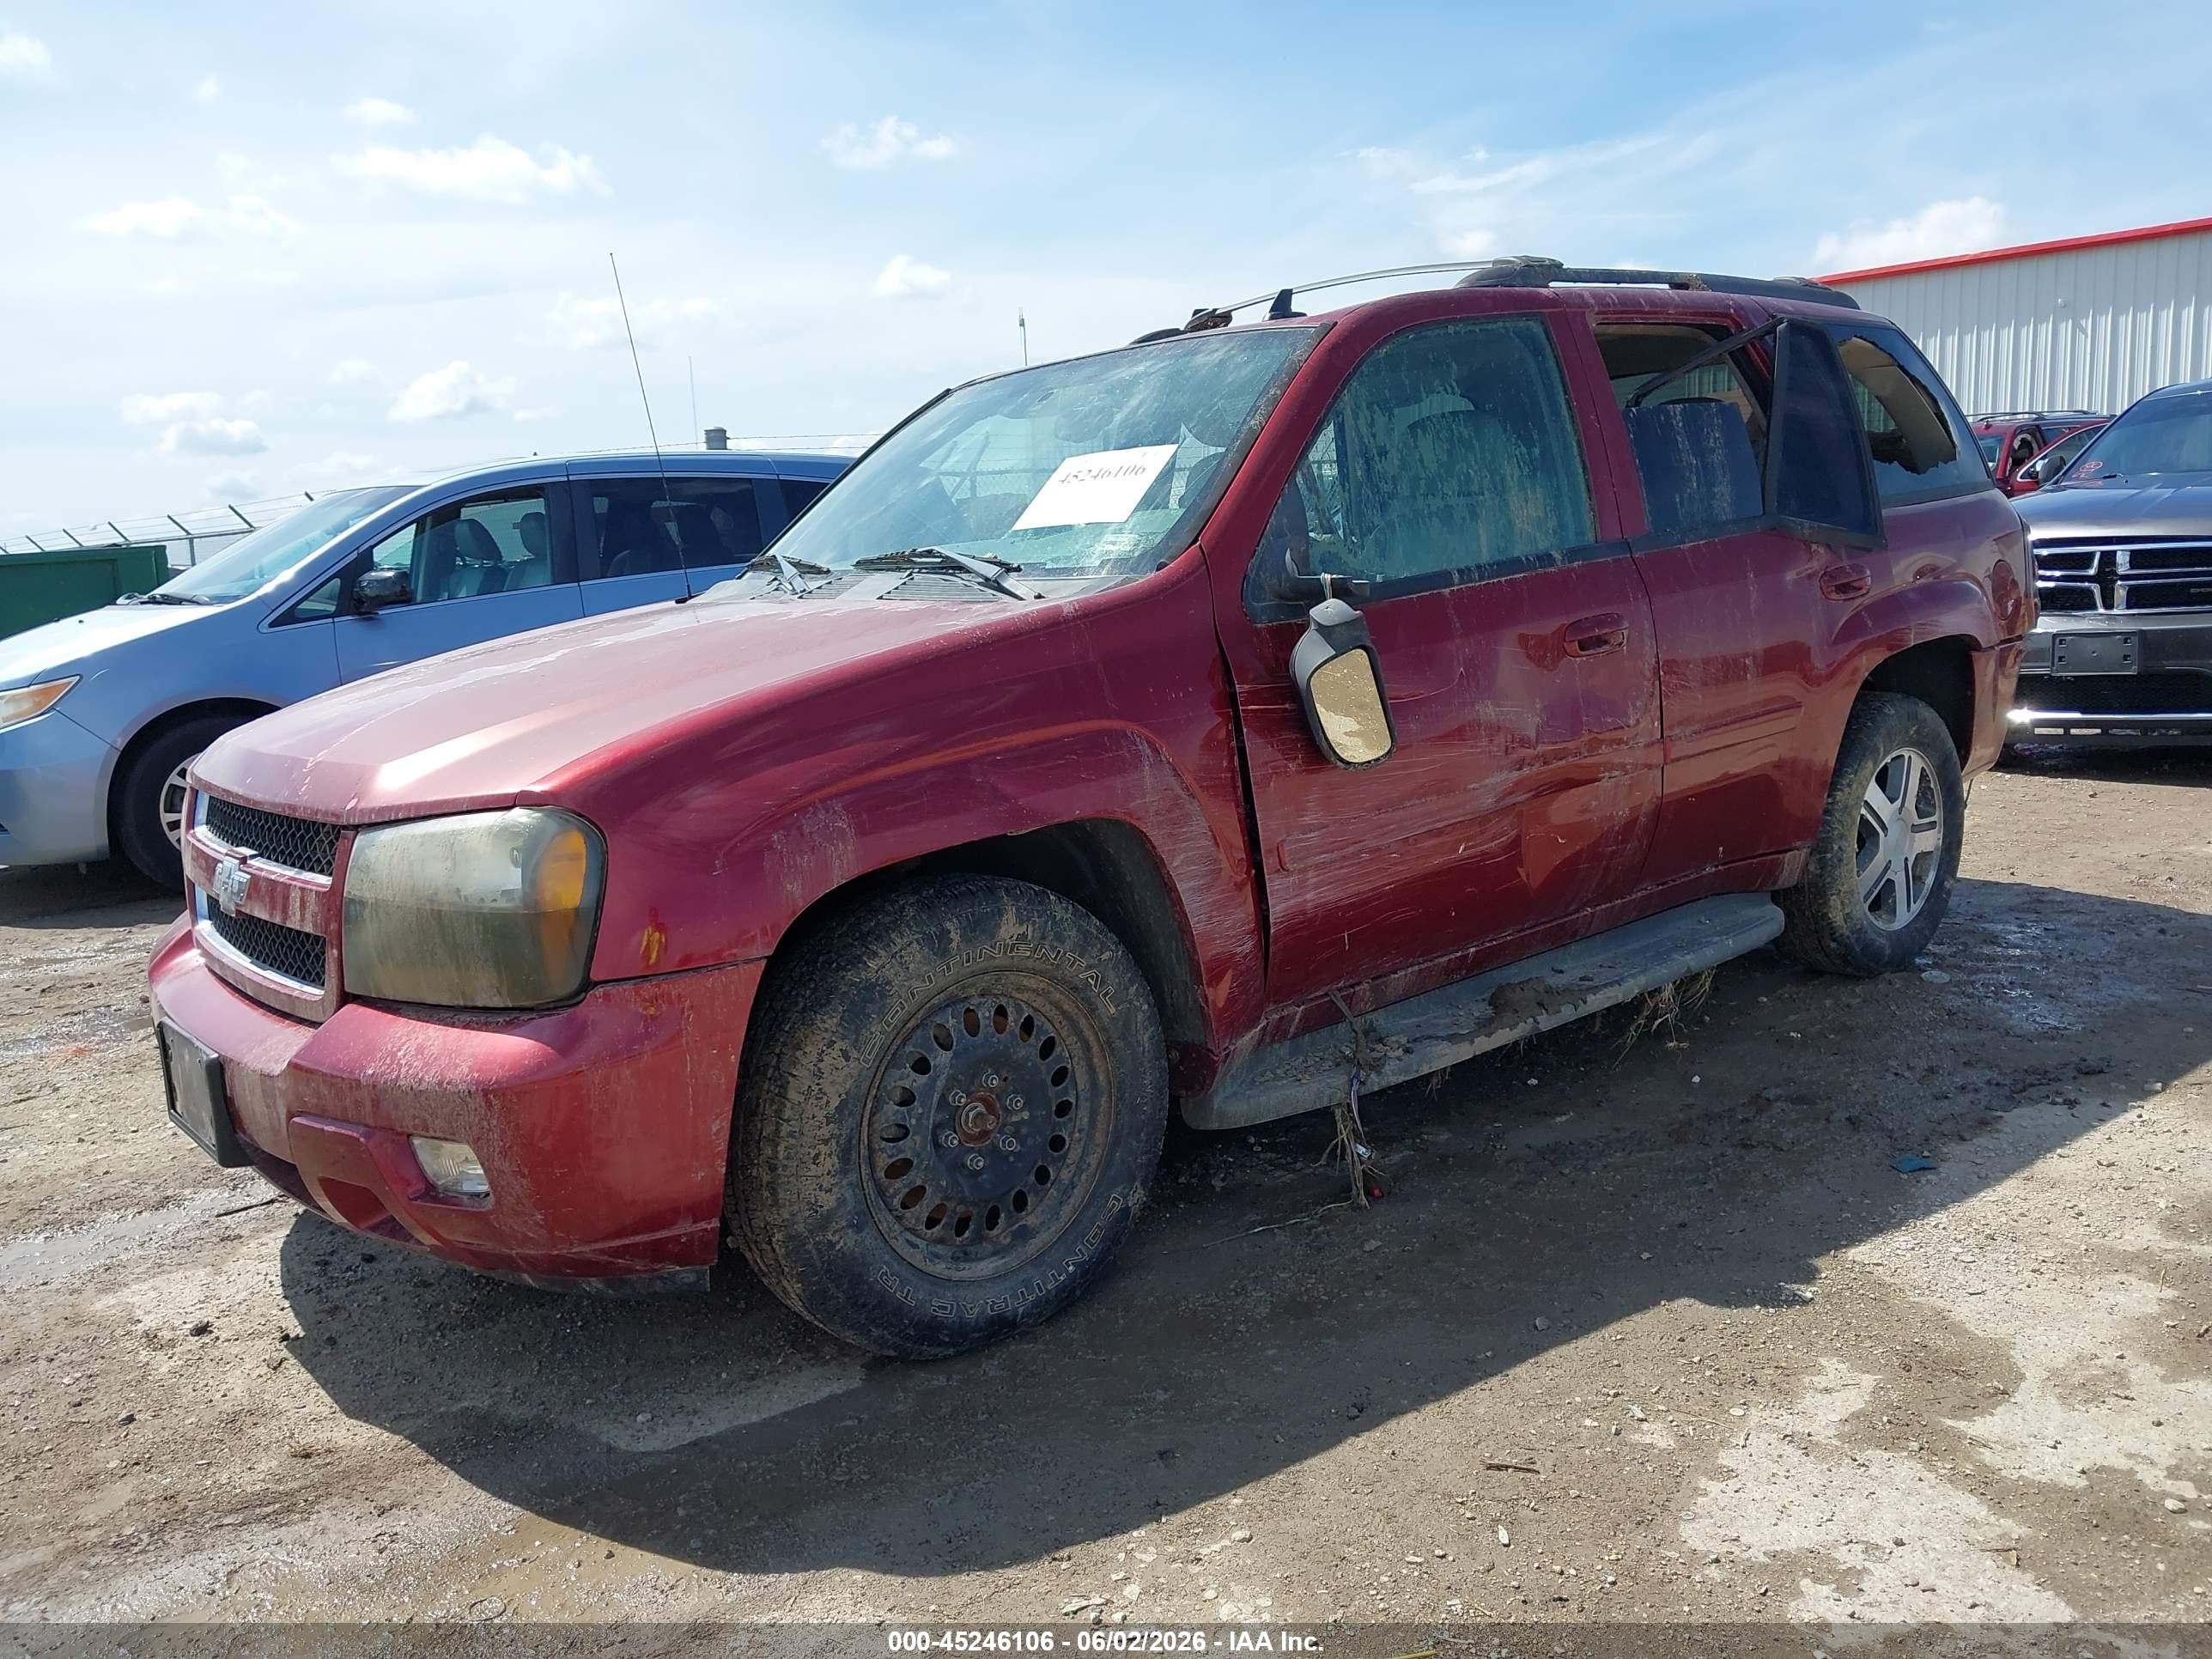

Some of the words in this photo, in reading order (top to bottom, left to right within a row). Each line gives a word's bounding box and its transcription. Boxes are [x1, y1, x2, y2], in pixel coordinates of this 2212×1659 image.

[1059, 465, 1146, 484] 45246106
[860, 941, 1115, 1068] CONTINENTAL
[878, 1266, 916, 1306] TR
[930, 1194, 1123, 1318] CONTITRAC
